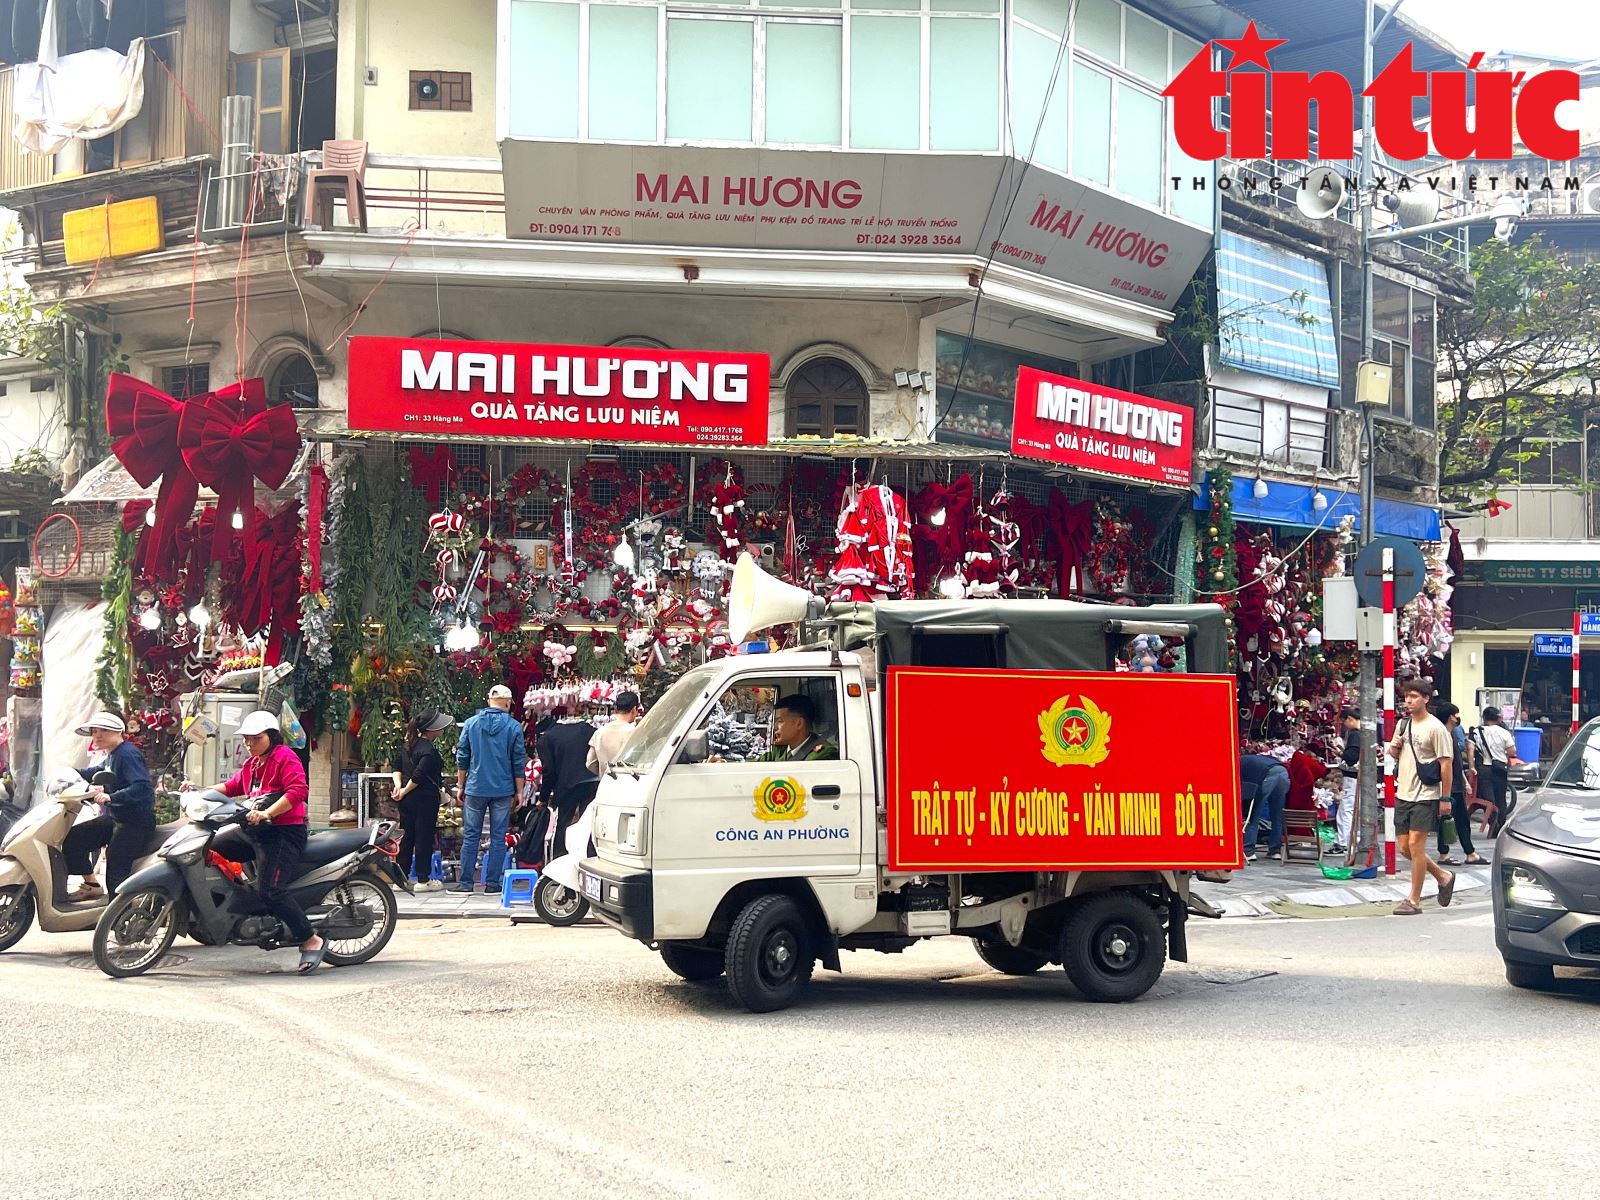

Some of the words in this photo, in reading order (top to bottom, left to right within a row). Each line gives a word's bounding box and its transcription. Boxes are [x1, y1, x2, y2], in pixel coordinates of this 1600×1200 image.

[636, 173, 709, 204] MAI
[723, 175, 863, 209] HƯƠNG
[538, 206, 573, 215] CHUYÊN
[600, 207, 630, 217] PHÒNG
[666, 210, 685, 219] QUÀ
[688, 211, 711, 221] TẶNG
[715, 213, 730, 221] LƯU
[734, 213, 755, 223] NIỆM
[760, 215, 776, 224] PHỤ
[779, 215, 797, 225] KIỆN
[801, 214, 814, 225] ĐỒ
[818, 217, 846, 225] TRANG
[850, 217, 862, 225] TRÍ
[878, 217, 893, 228] HỘI
[930, 216, 958, 228] THỐNG
[582, 224, 597, 236] 171
[900, 234, 928, 245] 3928
[932, 235, 961, 245] 3564
[1029, 200, 1084, 240] MAI
[1086, 221, 1169, 268] HƯƠNG
[1022, 251, 1033, 261] 171
[401, 349, 514, 394] MAI
[531, 355, 748, 403] HƯƠNG
[470, 399, 517, 421] QUÀ
[524, 402, 579, 427] TẶNG
[587, 405, 626, 424] LƯU
[631, 404, 680, 428] NIỆM
[1036, 382, 1090, 427] MAI
[1090, 394, 1183, 447] HƯƠNG
[1055, 431, 1079, 451] QUÀ
[1081, 433, 1109, 457] TẶNG
[1112, 443, 1130, 460] LƯU
[1132, 447, 1156, 467] NIỆM
[1539, 567, 1556, 578] TY
[1560, 565, 1592, 578] SIÊU
[1538, 643, 1557, 653] THUỐC
[911, 781, 951, 846] TRẬT
[955, 786, 976, 846] TỰ
[990, 776, 1010, 836] KỶ
[1015, 787, 1069, 837] CƯƠNG
[1083, 783, 1115, 836] VĂN
[1120, 792, 1161, 836] MINH
[1175, 783, 1196, 837] ĐÔ
[1200, 792, 1225, 846] THỊ
[715, 827, 759, 842] CÔNG
[763, 829, 784, 841] AN
[788, 826, 850, 841] PHƯỜNG
